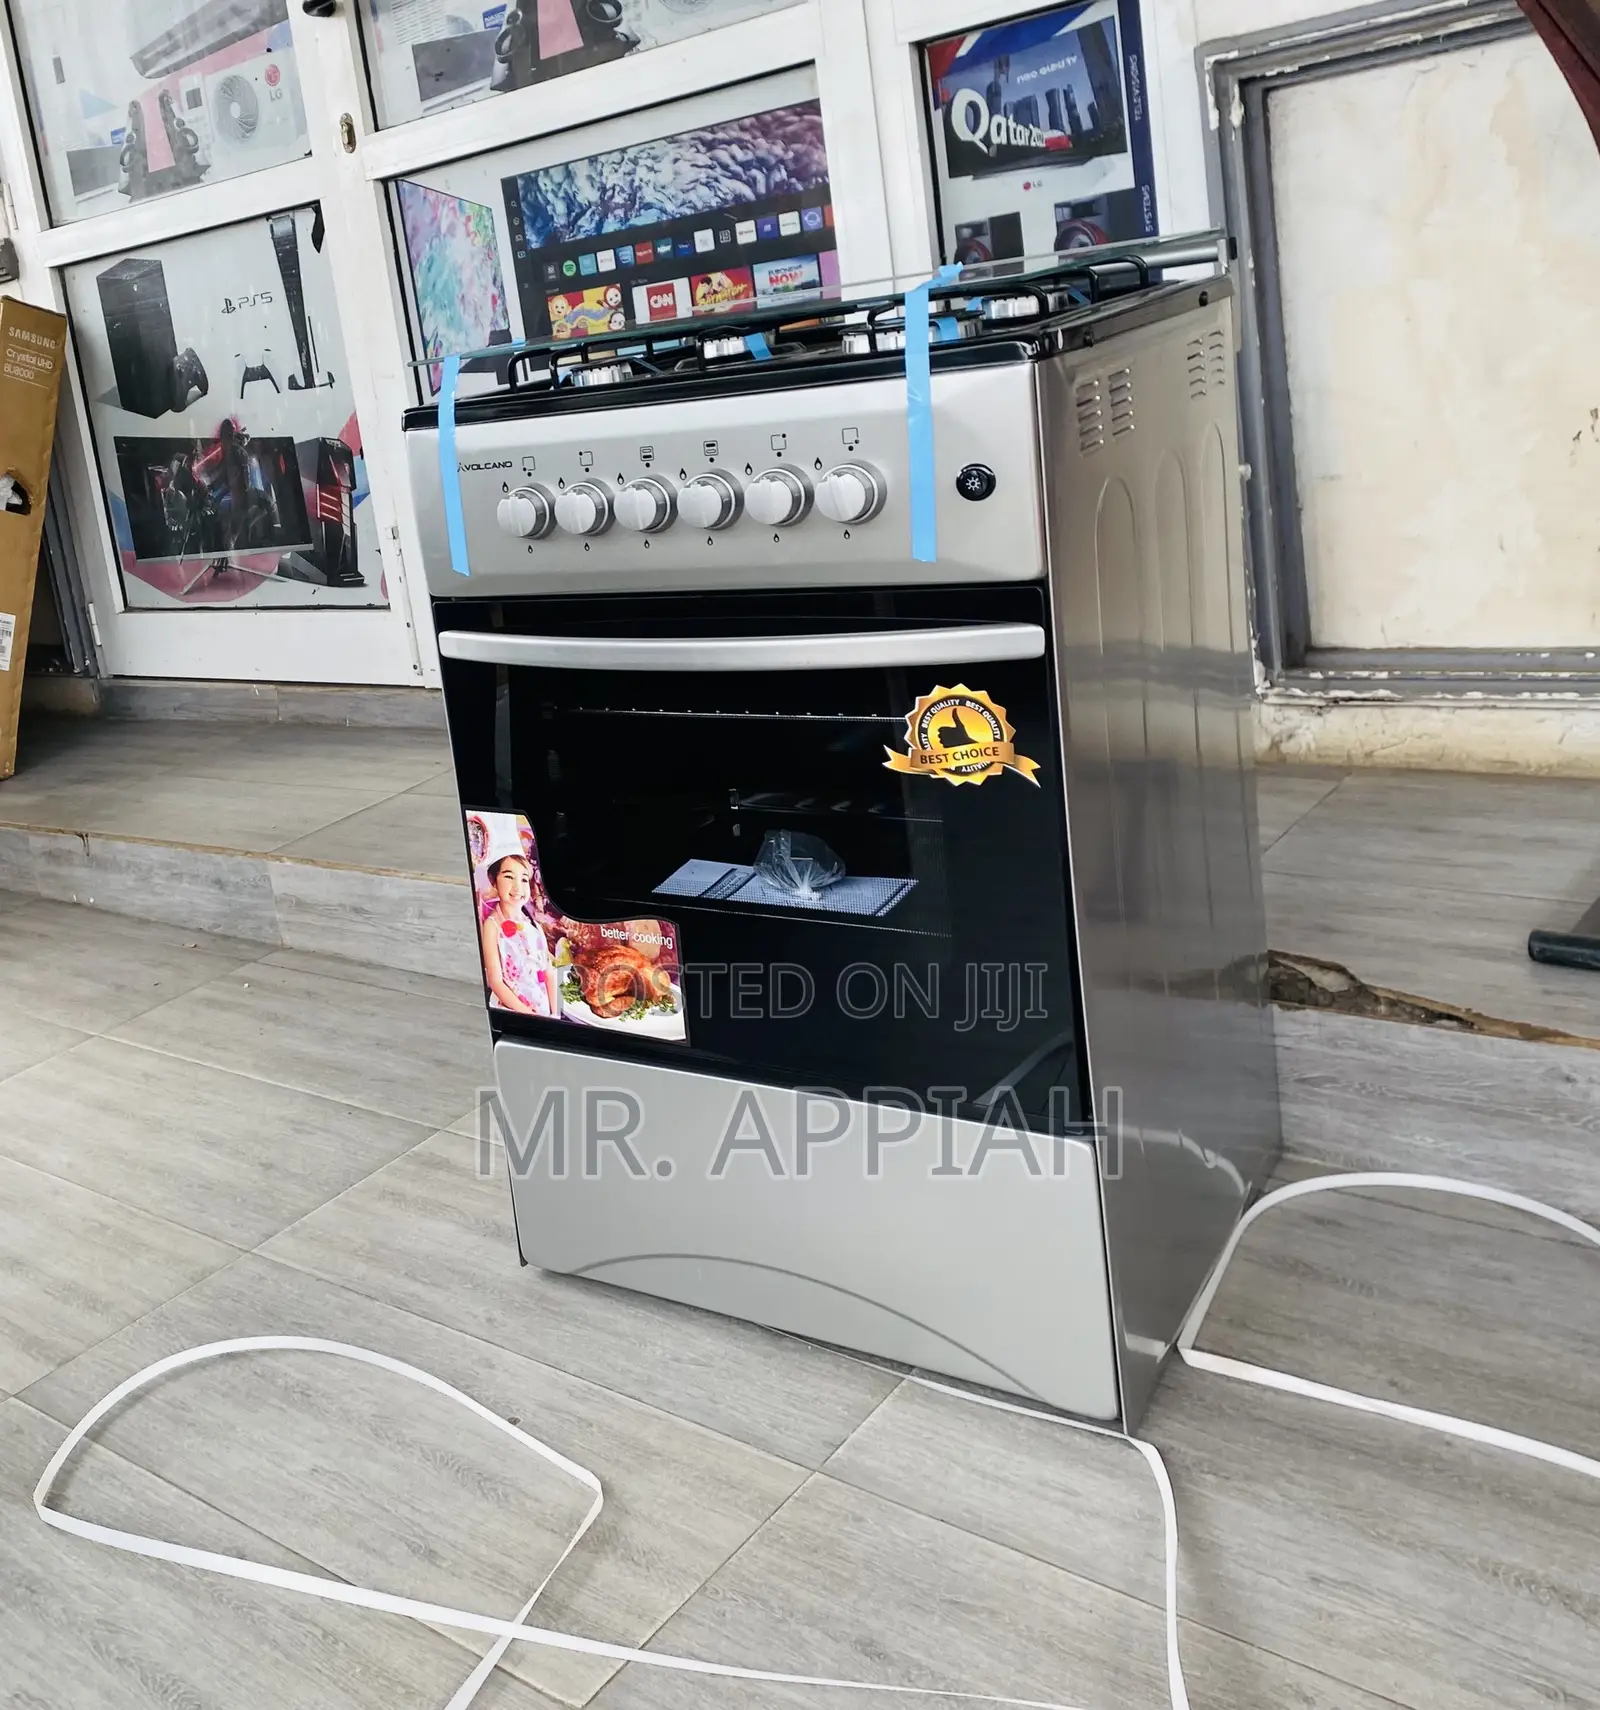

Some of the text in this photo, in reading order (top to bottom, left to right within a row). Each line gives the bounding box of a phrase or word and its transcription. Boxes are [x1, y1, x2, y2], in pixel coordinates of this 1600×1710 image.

[269, 87, 284, 102] LG
[1141, 184, 1154, 233] SYSTEMS
[237, 291, 273, 309] PS5
[649, 291, 674, 309] CNN
[8, 326, 57, 350] SAMSUNG
[6, 348, 53, 370] Crystal UHD
[464, 461, 513, 471] VOLCANO
[921, 699, 960, 729] BEST QUALITY
[965, 700, 1001, 740] BEST QUALITY
[920, 747, 1000, 765] BEST CHOICE
[601, 924, 673, 950] better cooking
